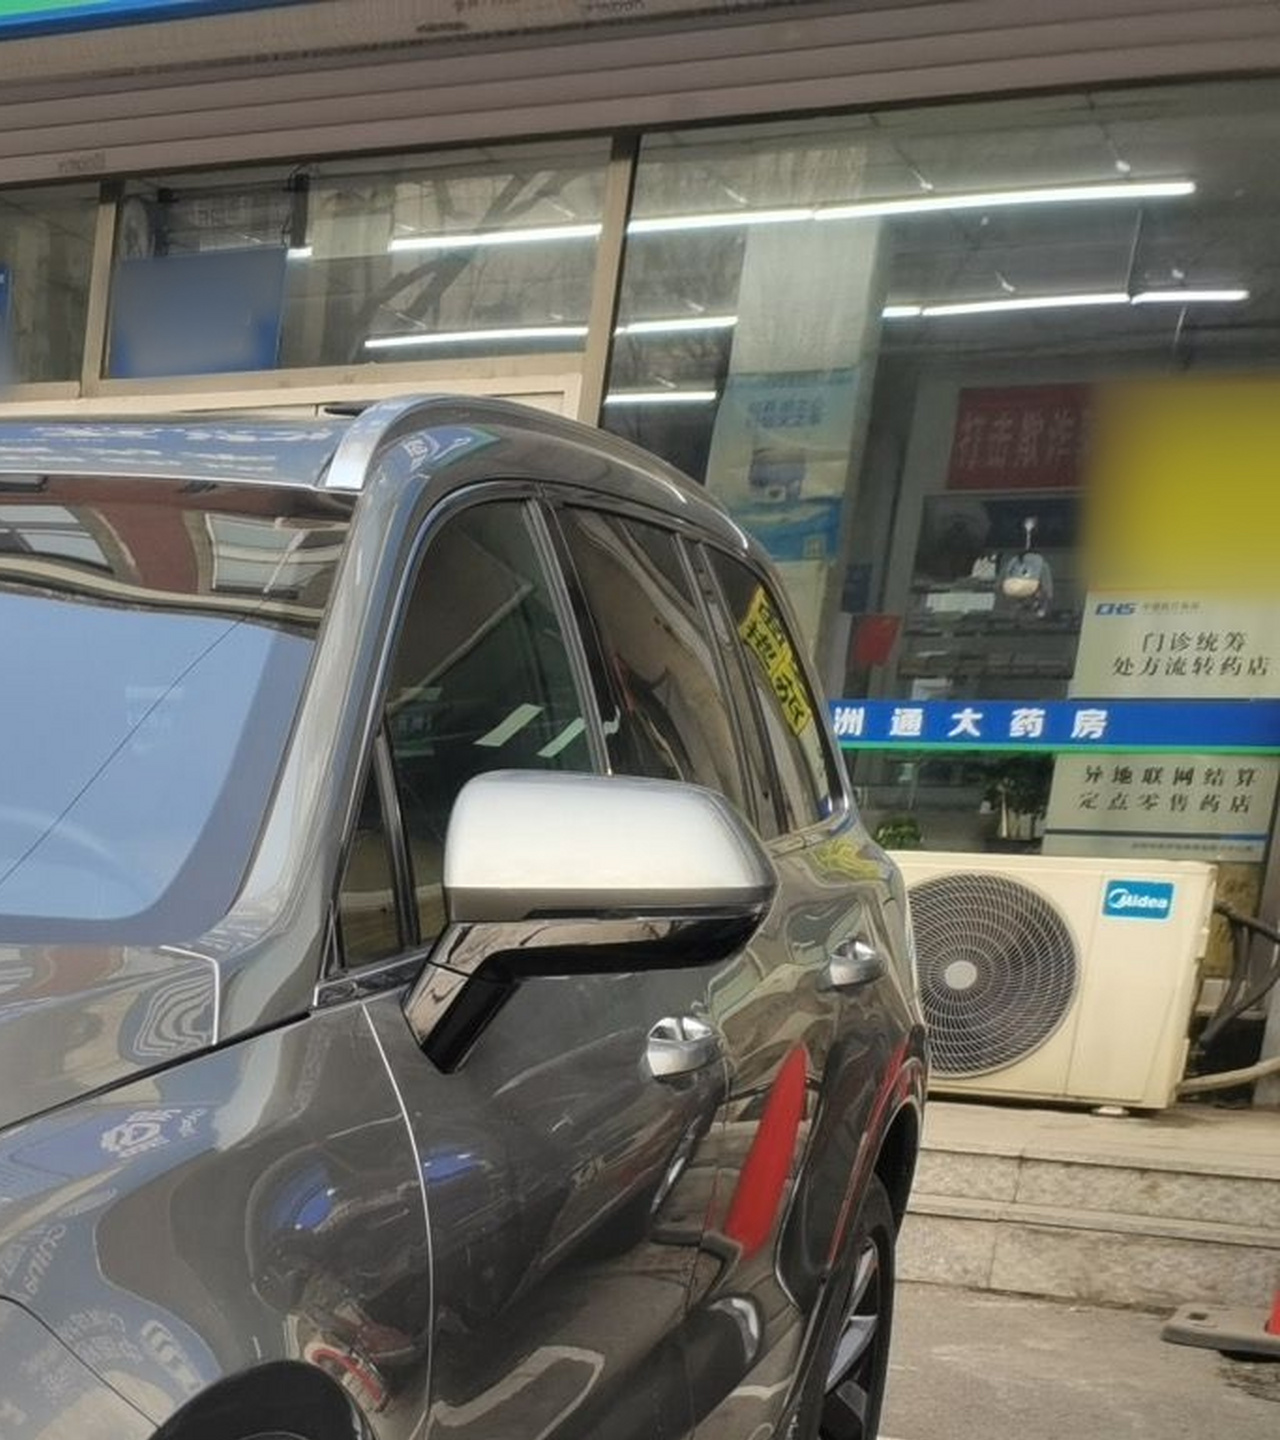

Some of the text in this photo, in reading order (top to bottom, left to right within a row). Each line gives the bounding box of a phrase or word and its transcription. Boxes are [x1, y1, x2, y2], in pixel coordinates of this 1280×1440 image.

[1141, 630, 1248, 653] 门诊统筹
[1112, 655, 1271, 677] 处方流转药店
[833, 706, 1108, 739] 洲通大药房
[1085, 764, 1256, 787] 异地联网结算
[1077, 791, 1253, 813] 定点零售药店
[1108, 888, 1169, 909] Midea
